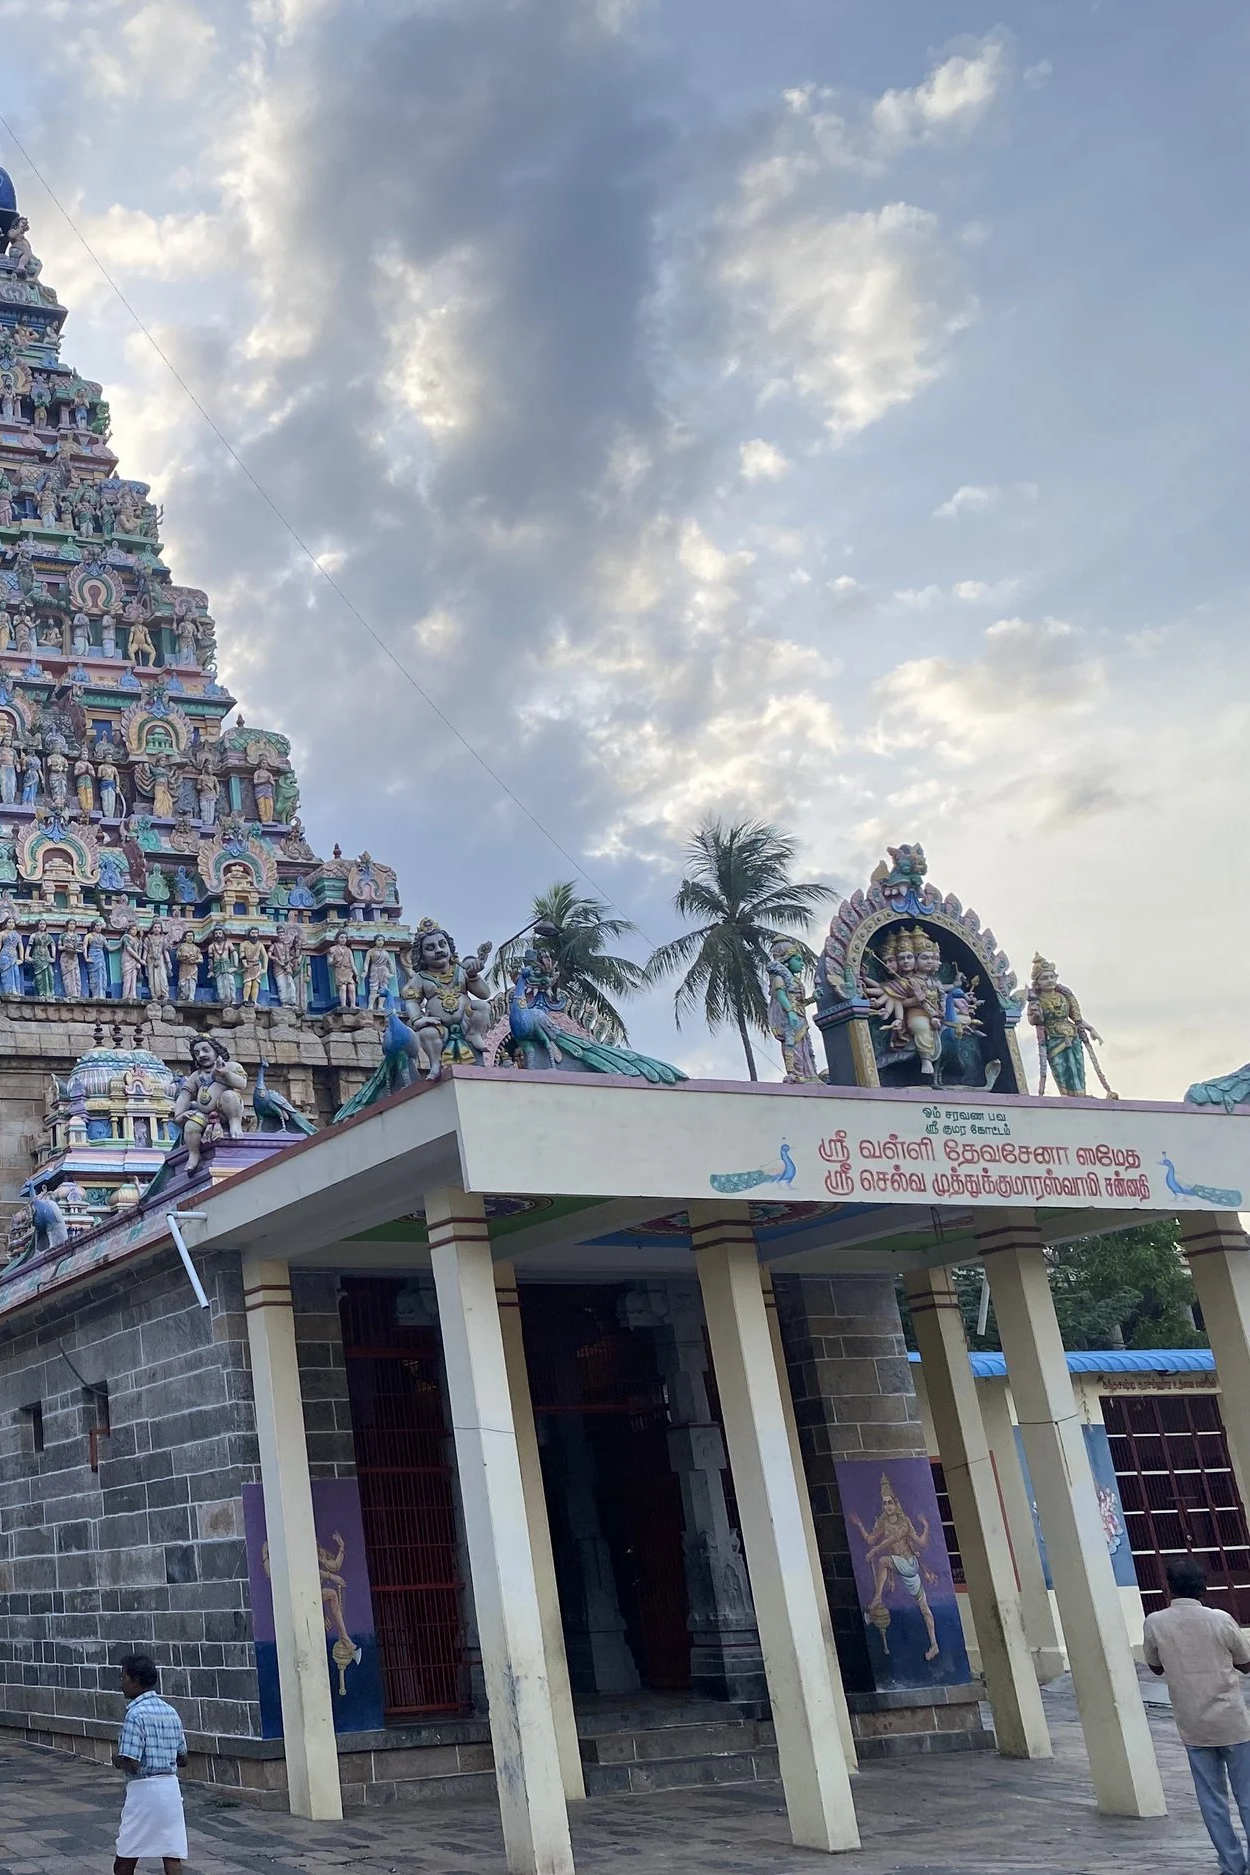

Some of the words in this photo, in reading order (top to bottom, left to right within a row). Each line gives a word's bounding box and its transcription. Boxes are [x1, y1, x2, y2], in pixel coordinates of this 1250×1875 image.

[943, 1125, 967, 1136] குமர
[970, 1123, 1011, 1136] கோட்டம்
[945, 1111, 984, 1122] சரவண
[988, 1112, 1006, 1122] பவ
[819, 1129, 850, 1163] ஸ்ரீ
[860, 1133, 936, 1161] வள்ளி
[944, 1138, 1070, 1168] தேவசேனா
[1076, 1143, 1142, 1171] ஸமேத
[825, 1162, 855, 1196] ஸ்ரீ
[859, 1164, 927, 1193] செல்வ
[932, 1166, 1102, 1201] முத்துக்குமாரஸ்வாமி
[1104, 1170, 1150, 1202] சன்னதி
